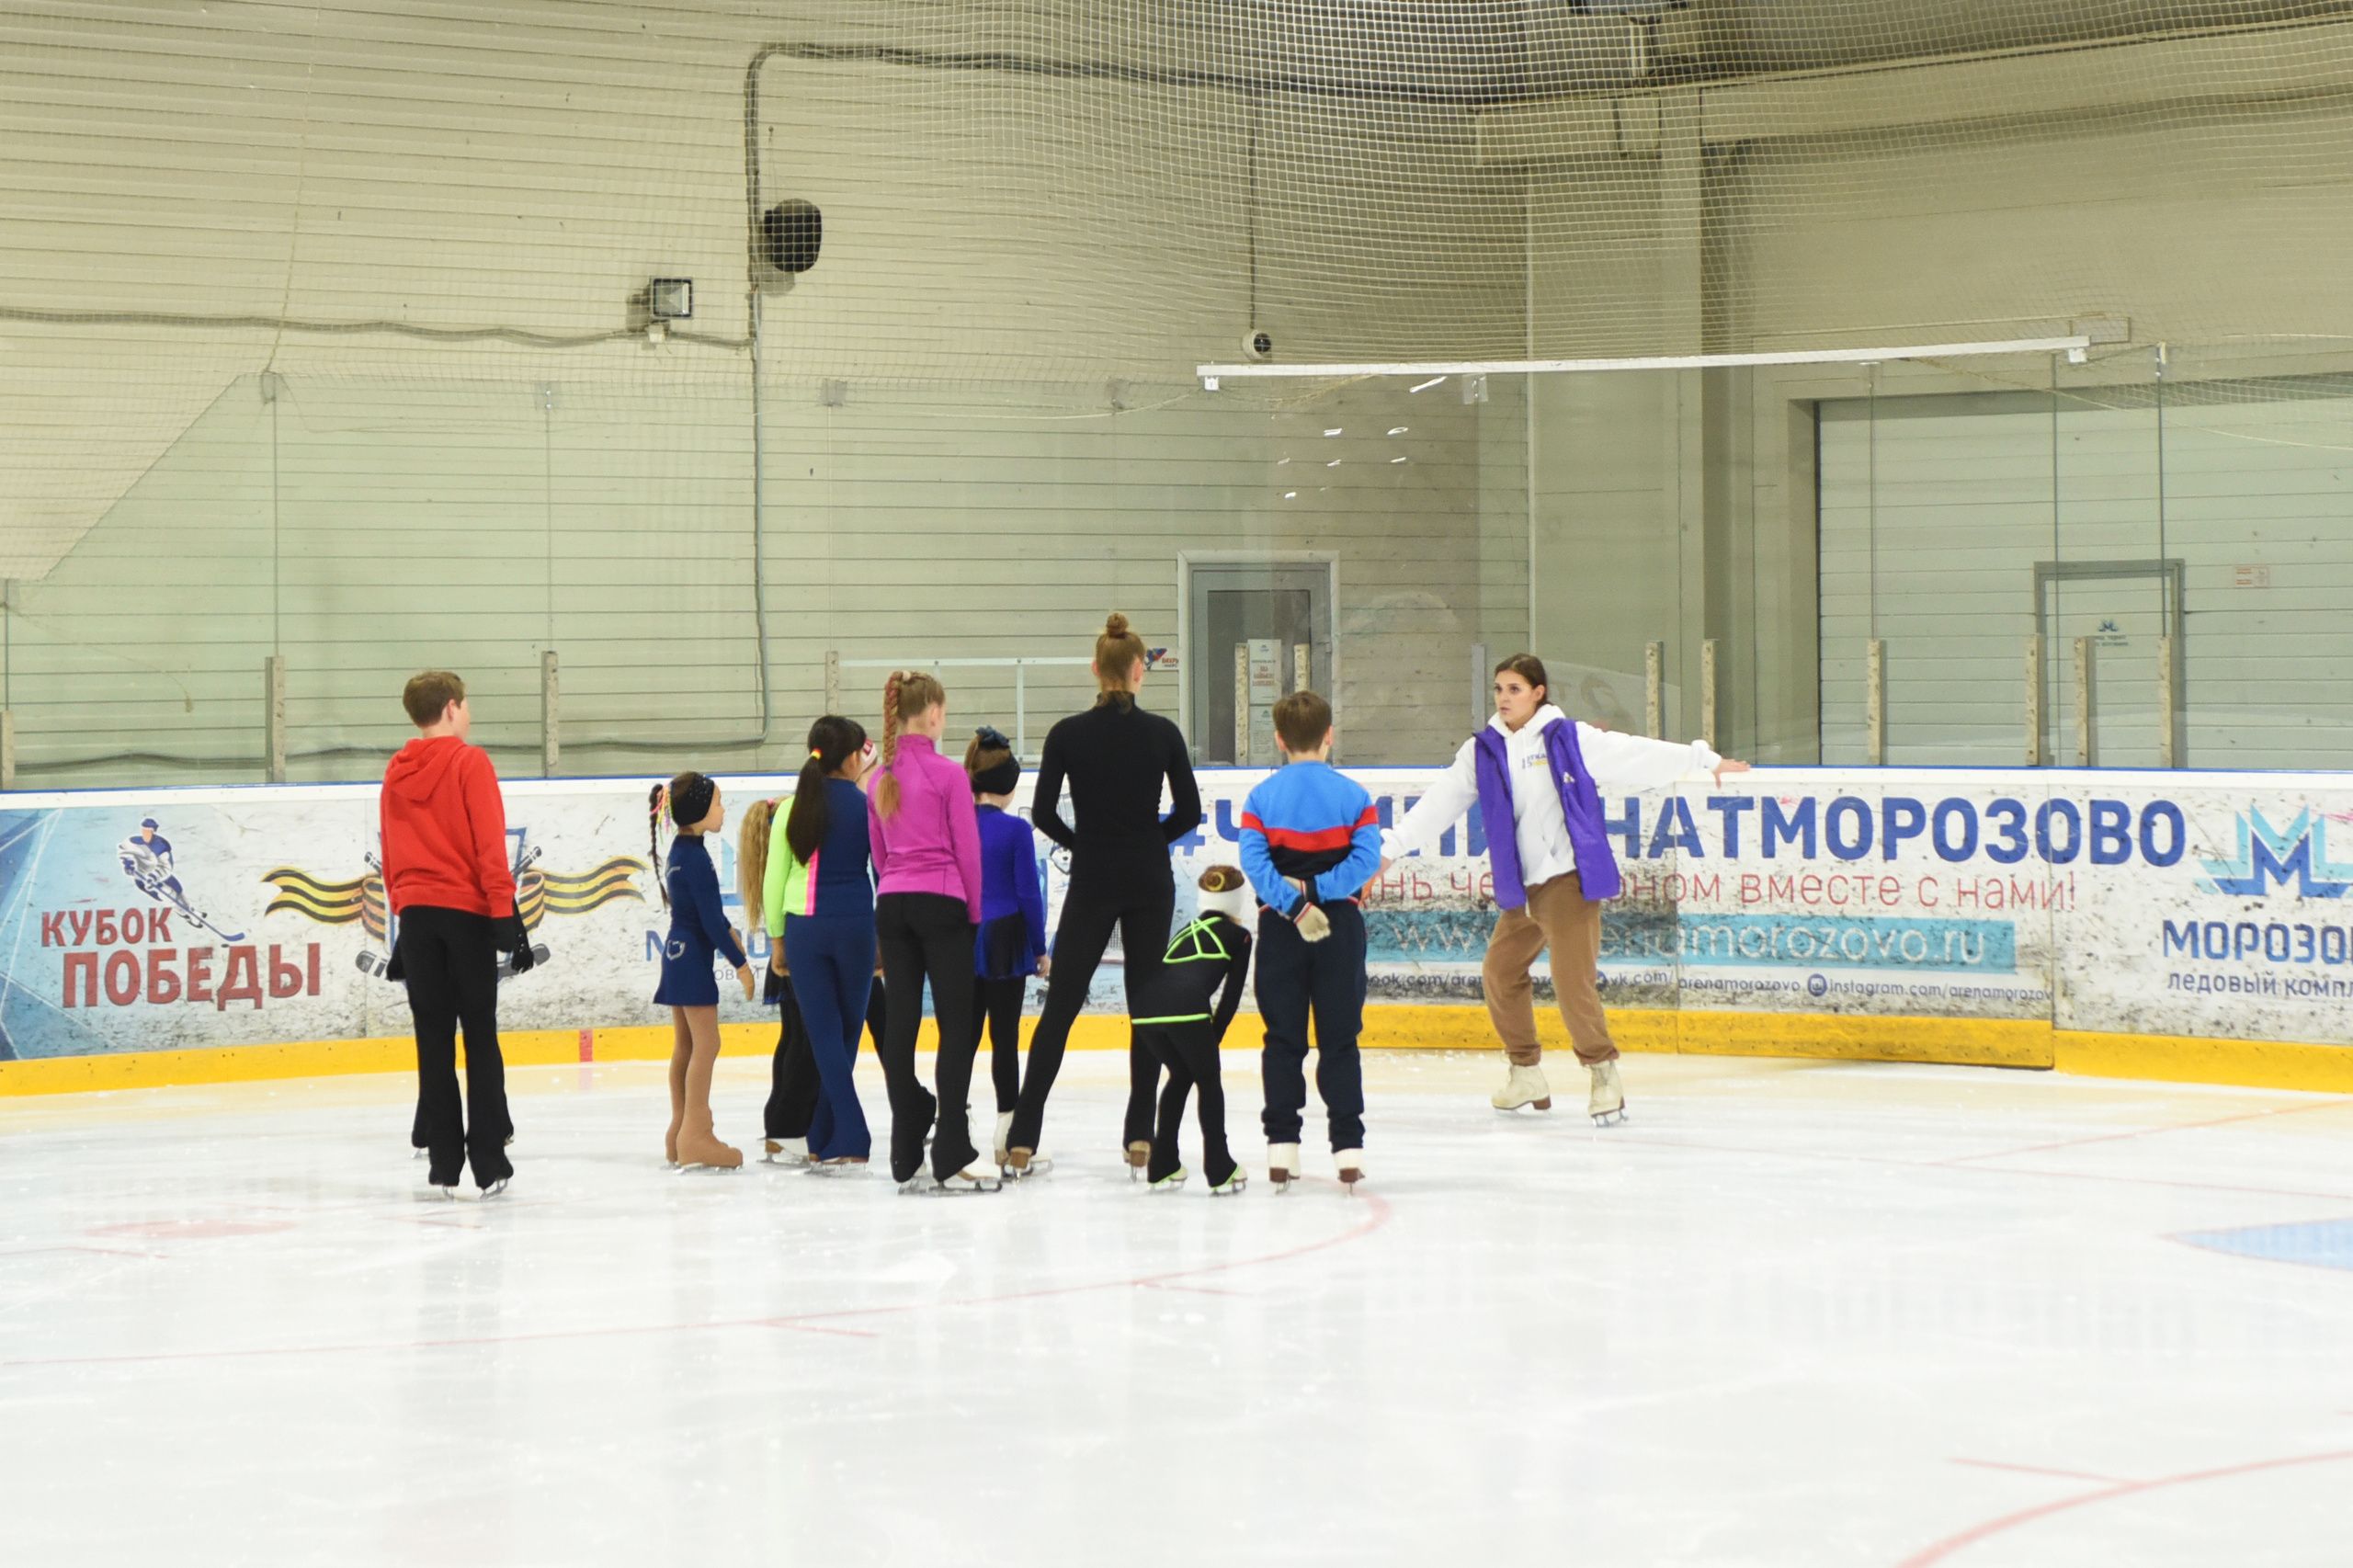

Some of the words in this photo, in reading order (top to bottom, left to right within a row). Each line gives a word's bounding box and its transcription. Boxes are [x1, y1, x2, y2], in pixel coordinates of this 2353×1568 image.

[1741, 872, 1900, 905] вместе
[1918, 876, 1939, 907] с
[1957, 870, 2075, 910] нами!
[41, 907, 172, 948] КУБОК
[2163, 919, 2353, 965] МОРОЗО
[62, 942, 321, 1011] ПОБЕДЫ
[2167, 971, 2277, 994] ледовый
